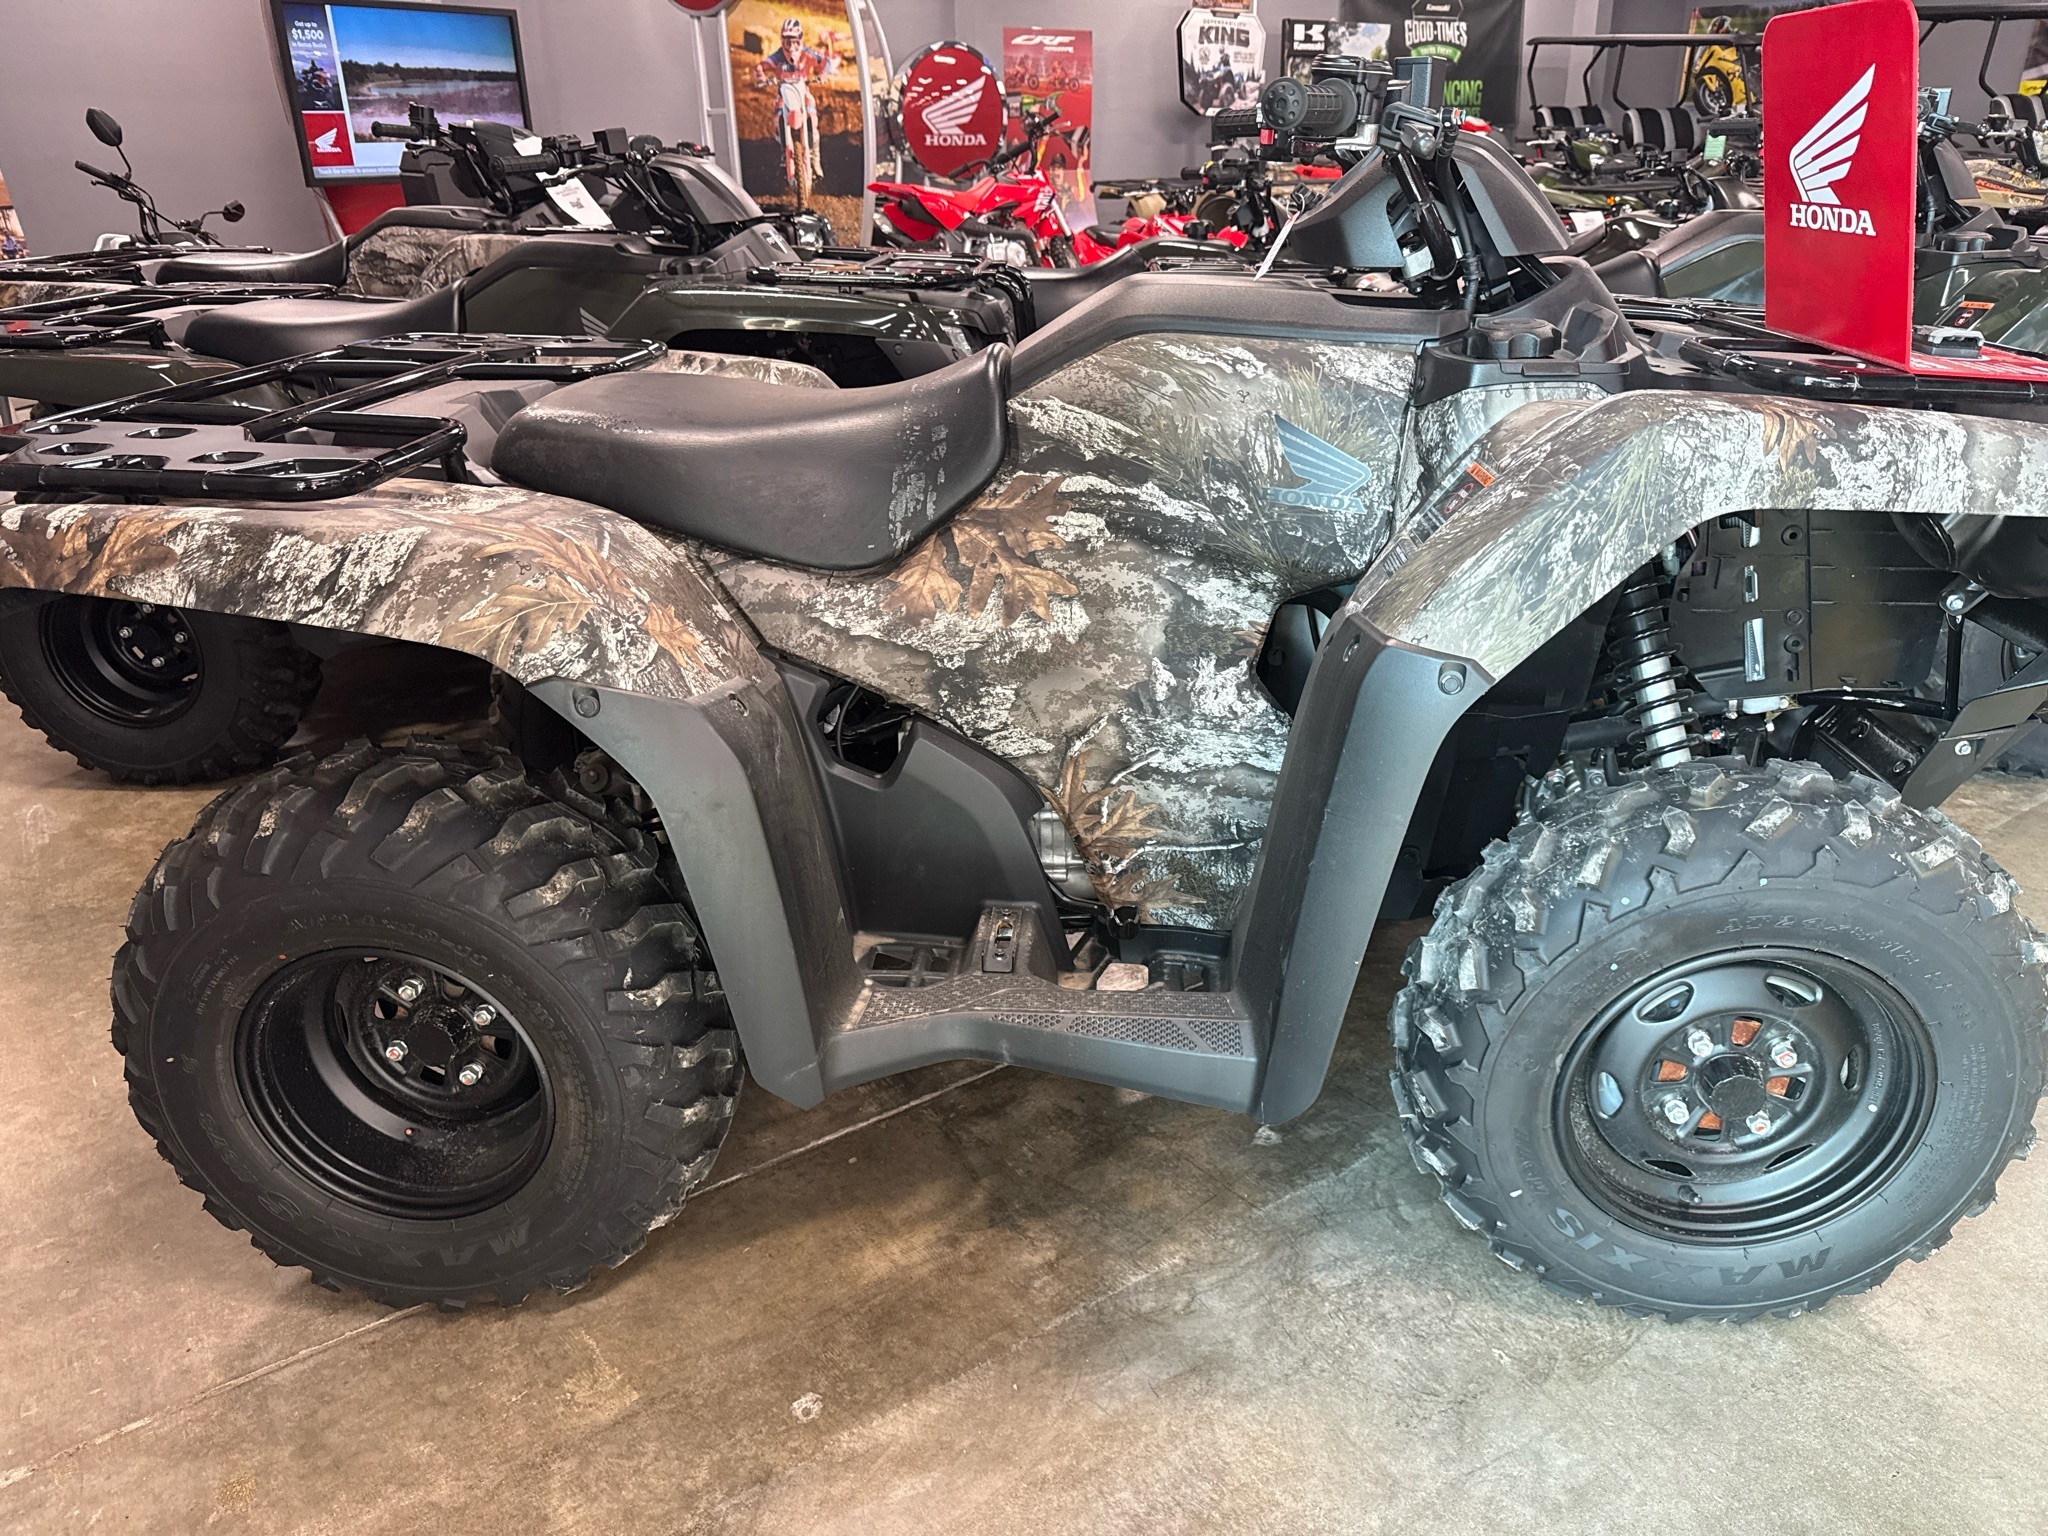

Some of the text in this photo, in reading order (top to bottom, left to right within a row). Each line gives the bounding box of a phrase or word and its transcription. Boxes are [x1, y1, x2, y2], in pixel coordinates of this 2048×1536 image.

[291, 27, 325, 41] $1,500
[1011, 34, 1076, 46] CRF
[1198, 25, 1250, 48] KING
[1442, 80, 1484, 106] NCING
[924, 133, 987, 147] HONDA
[1789, 203, 1877, 236] HONDA
[1260, 486, 1368, 515] HONDA
[1548, 1207, 1834, 1288] MAXXIS
